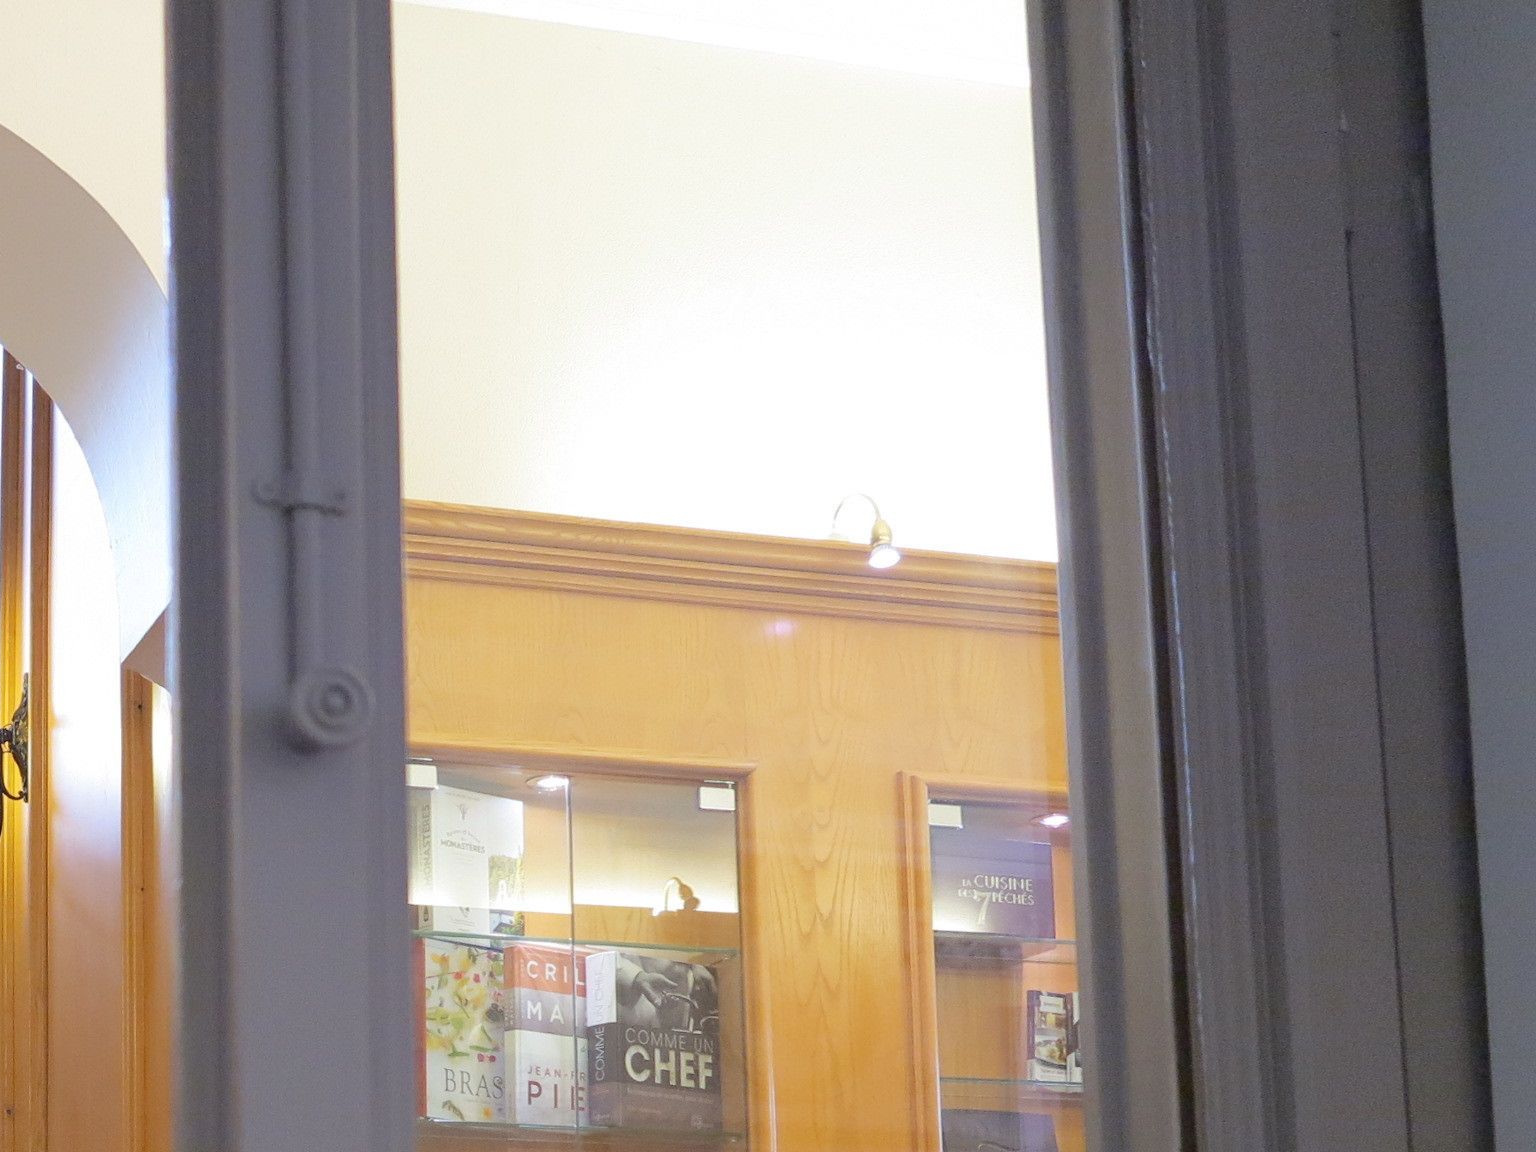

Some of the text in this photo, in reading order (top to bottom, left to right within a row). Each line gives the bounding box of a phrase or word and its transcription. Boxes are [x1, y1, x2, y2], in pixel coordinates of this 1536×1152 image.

[974, 874, 1033, 892] CUISINE
[992, 890, 1035, 906] PÉCHÉS
[526, 960, 585, 986] CRIL
[526, 1000, 565, 1025] MA
[594, 1026, 605, 1081] COMME
[625, 1027, 714, 1054] COMME UN
[625, 1044, 713, 1090] CHEF
[443, 1067, 505, 1100] BRAS
[527, 1080, 586, 1112] PIE
